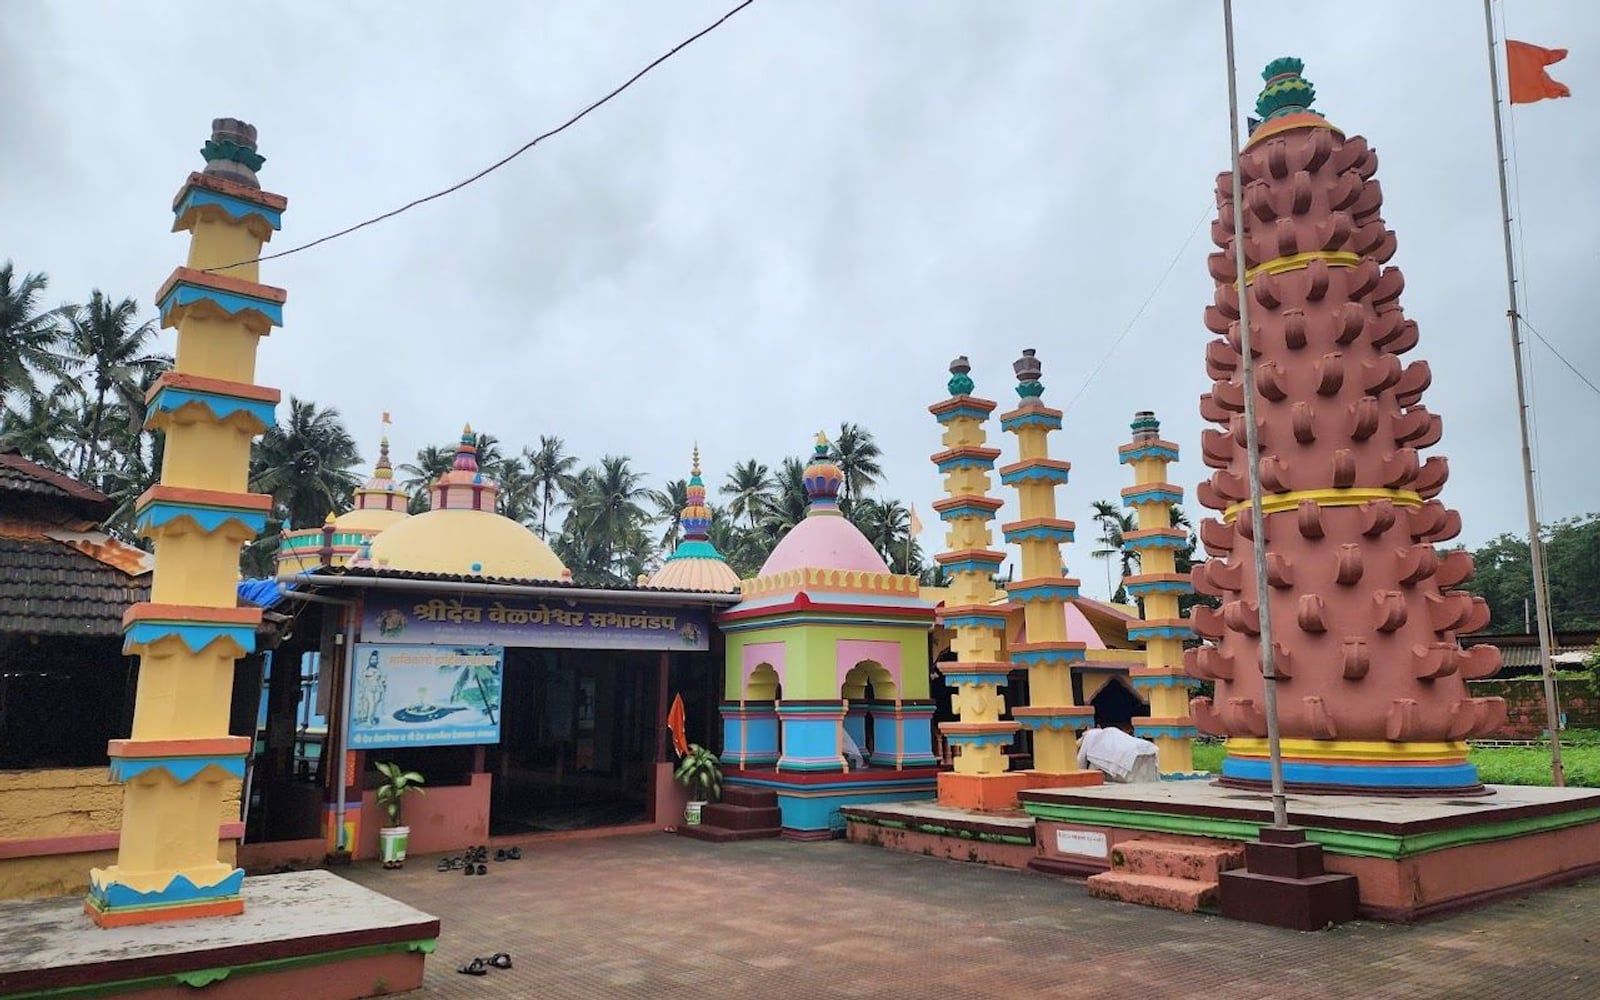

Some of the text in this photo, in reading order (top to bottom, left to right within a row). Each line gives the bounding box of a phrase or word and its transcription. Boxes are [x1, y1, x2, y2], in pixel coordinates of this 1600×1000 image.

[413, 599, 676, 630] श्रीदेव वेळणेश्वर सभामंडप
